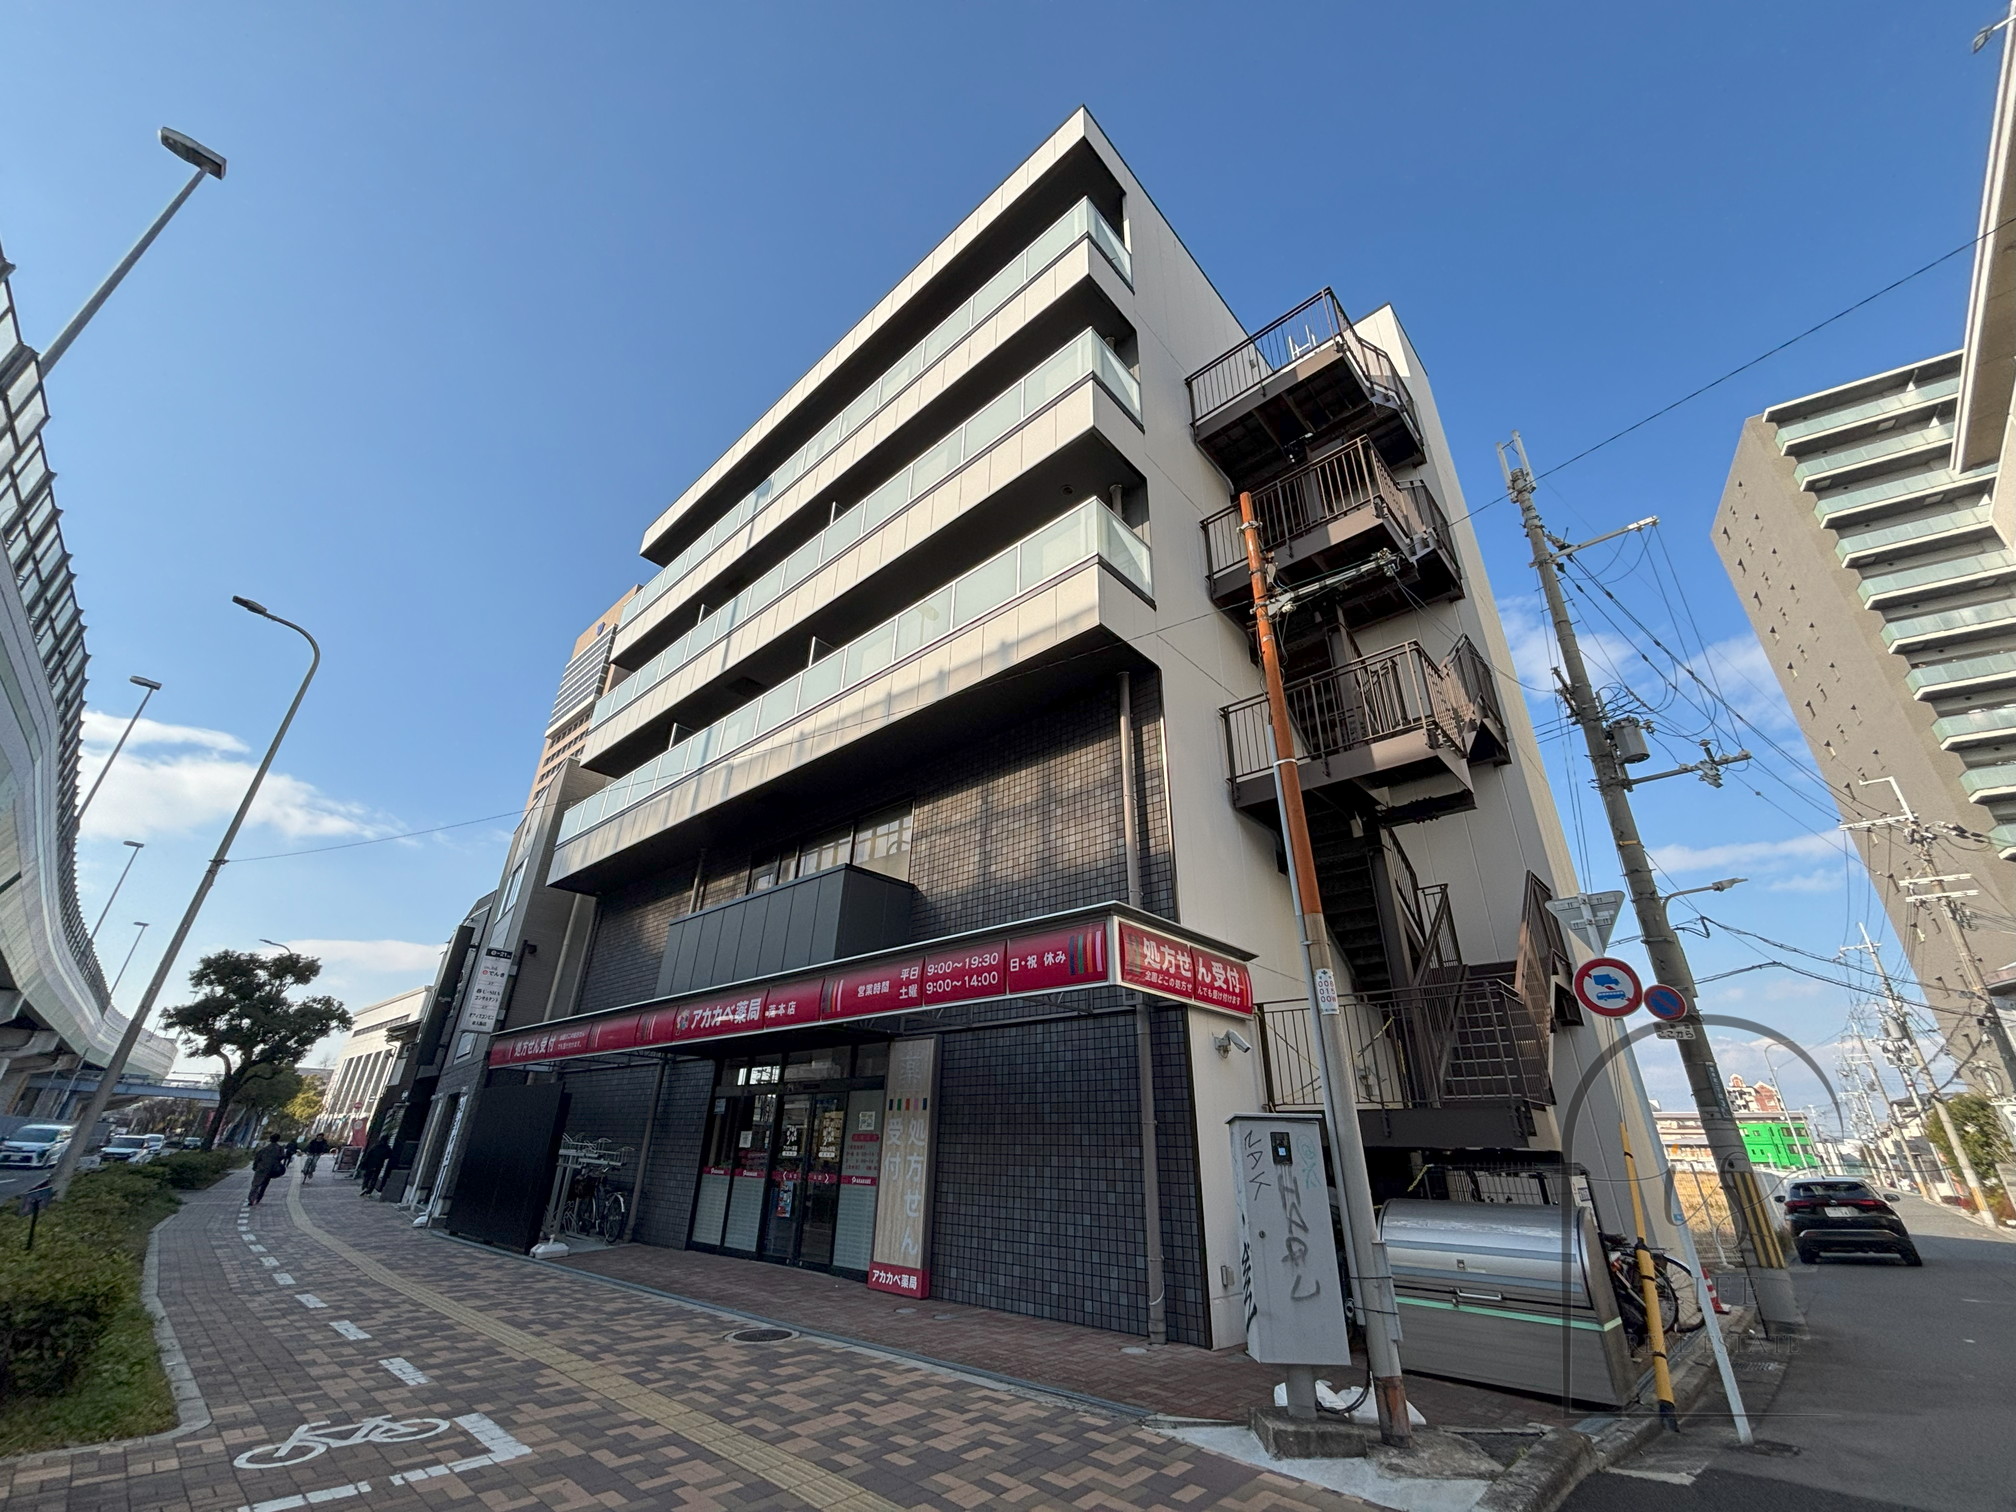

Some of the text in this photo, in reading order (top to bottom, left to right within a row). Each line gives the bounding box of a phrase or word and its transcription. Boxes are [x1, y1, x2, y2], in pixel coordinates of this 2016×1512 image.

[1010, 951, 1066, 972] 日・祝 休み
[1143, 937, 1239, 994] 処方せん受付
[900, 966, 919, 981] 平日
[857, 980, 890, 998] 営業時間
[899, 984, 918, 999] 土曜
[690, 997, 763, 1029] アカカベ薬局
[514, 1035, 557, 1057] 処方せん受付
[871, 1269, 918, 1291] アカカベ薬局
